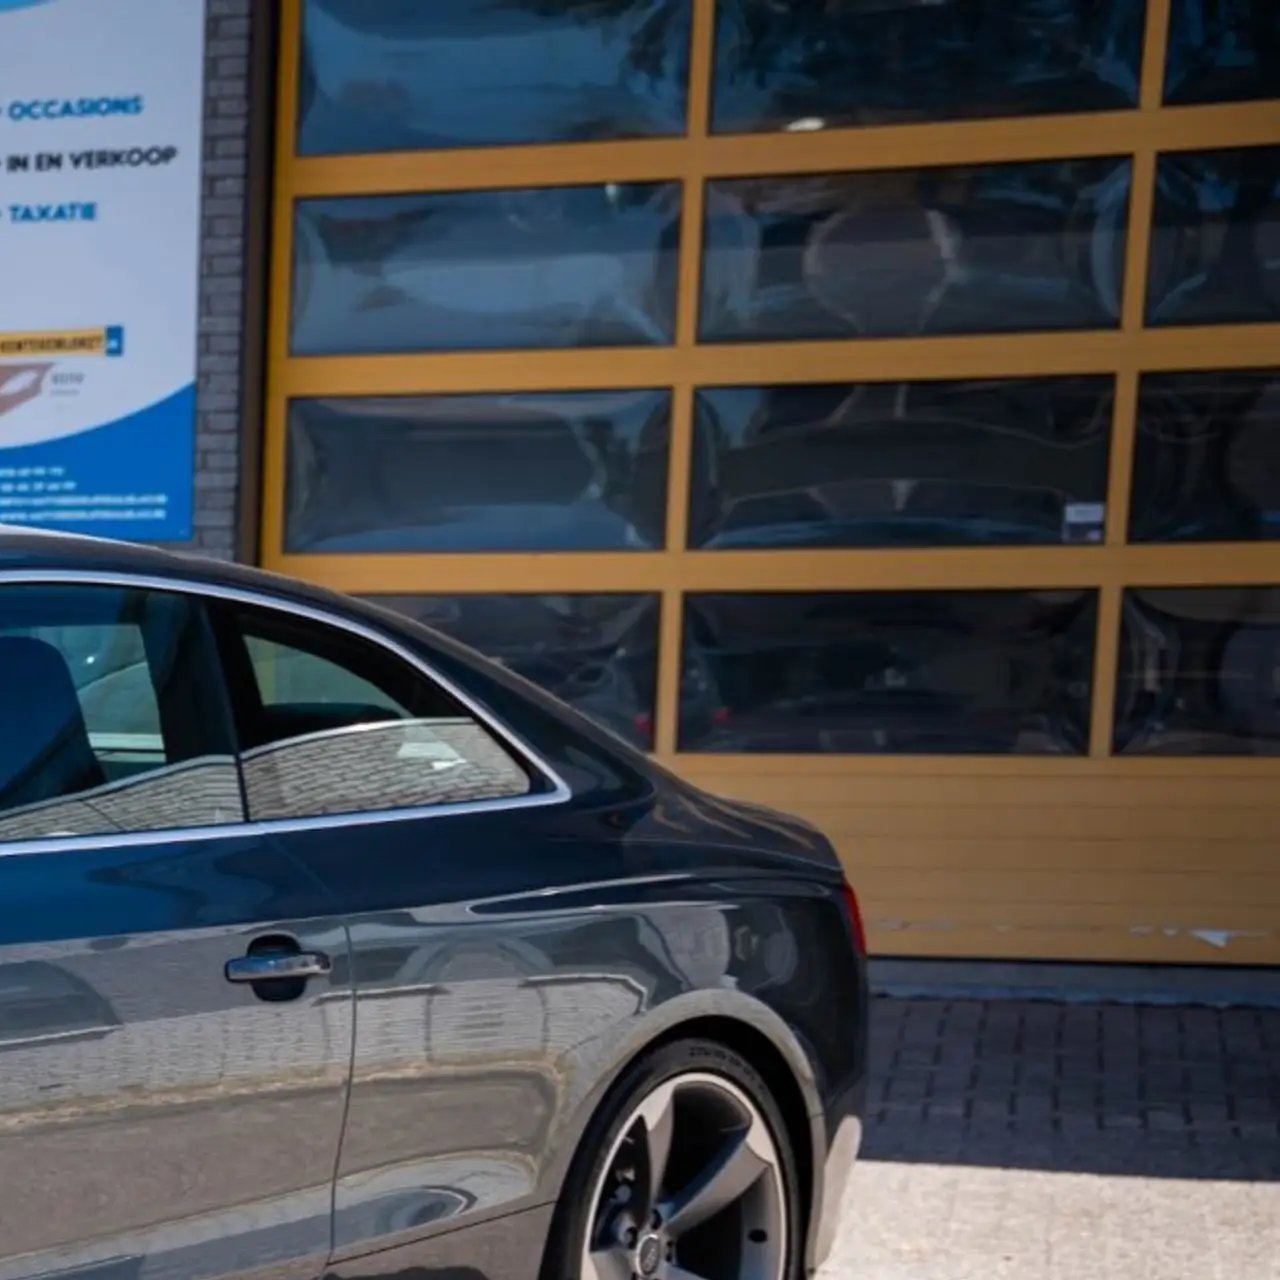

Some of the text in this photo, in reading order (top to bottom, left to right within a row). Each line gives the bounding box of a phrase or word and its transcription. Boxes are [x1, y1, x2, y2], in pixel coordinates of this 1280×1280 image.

[8, 95, 143, 120] OCCASIONS
[7, 146, 177, 172] IN EN VERKOOP
